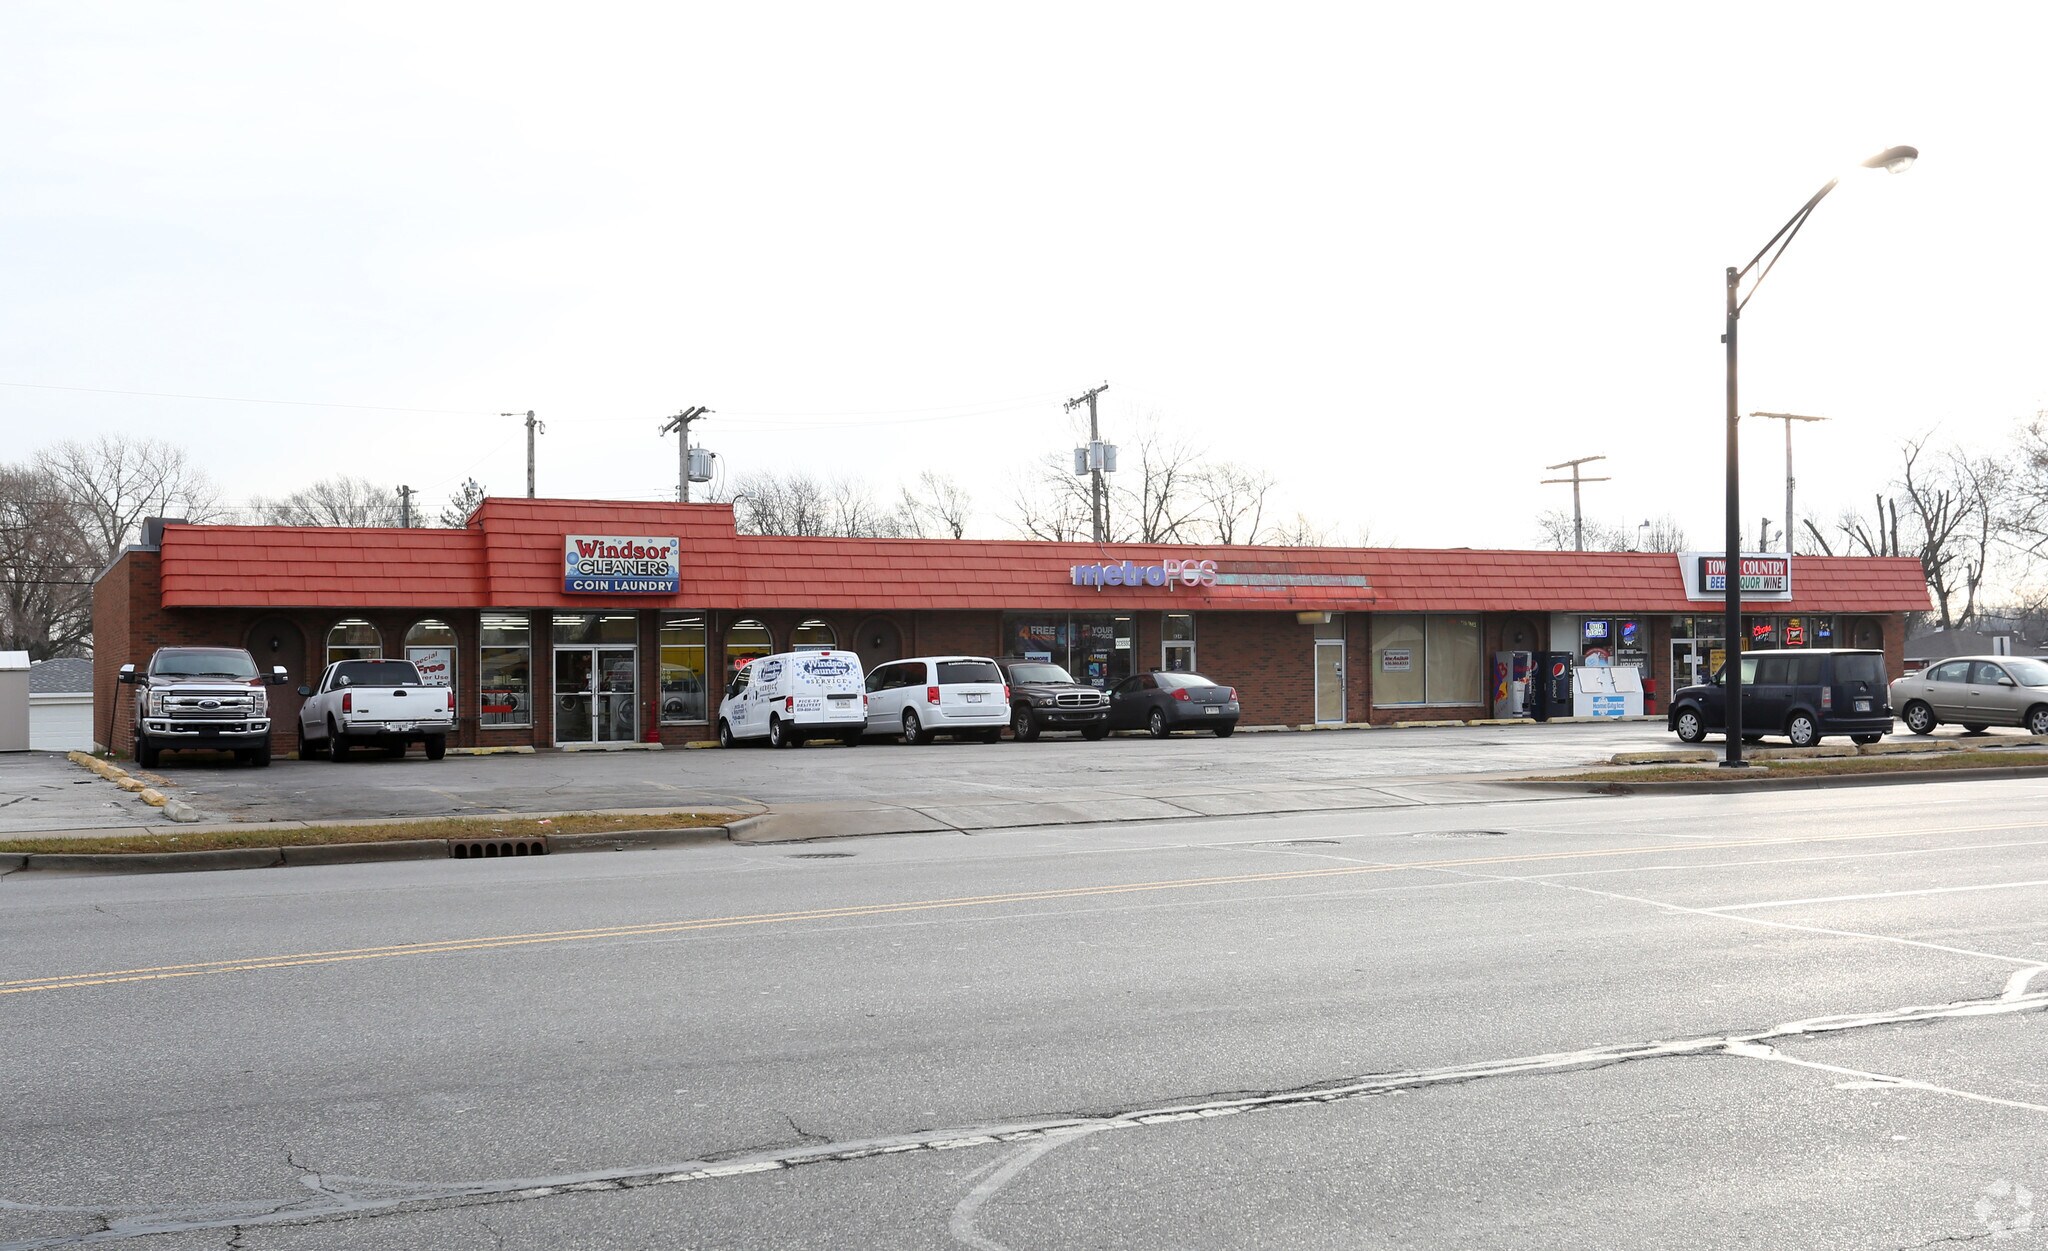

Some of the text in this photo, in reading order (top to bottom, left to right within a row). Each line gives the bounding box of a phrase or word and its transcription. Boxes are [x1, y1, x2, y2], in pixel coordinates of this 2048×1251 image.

[575, 540, 670, 559] Windsor
[578, 560, 669, 576] CLEANERS
[1070, 559, 1218, 588] metroPCS
[1707, 560, 1785, 575] TOW COUNTRY
[573, 580, 673, 591] COIN LAUNDRY
[1710, 576, 1782, 589] BEE QUOR WINE
[1019, 626, 1055, 639] 4 FREE
[417, 663, 445, 674] Free
[809, 668, 846, 677] Laundry
